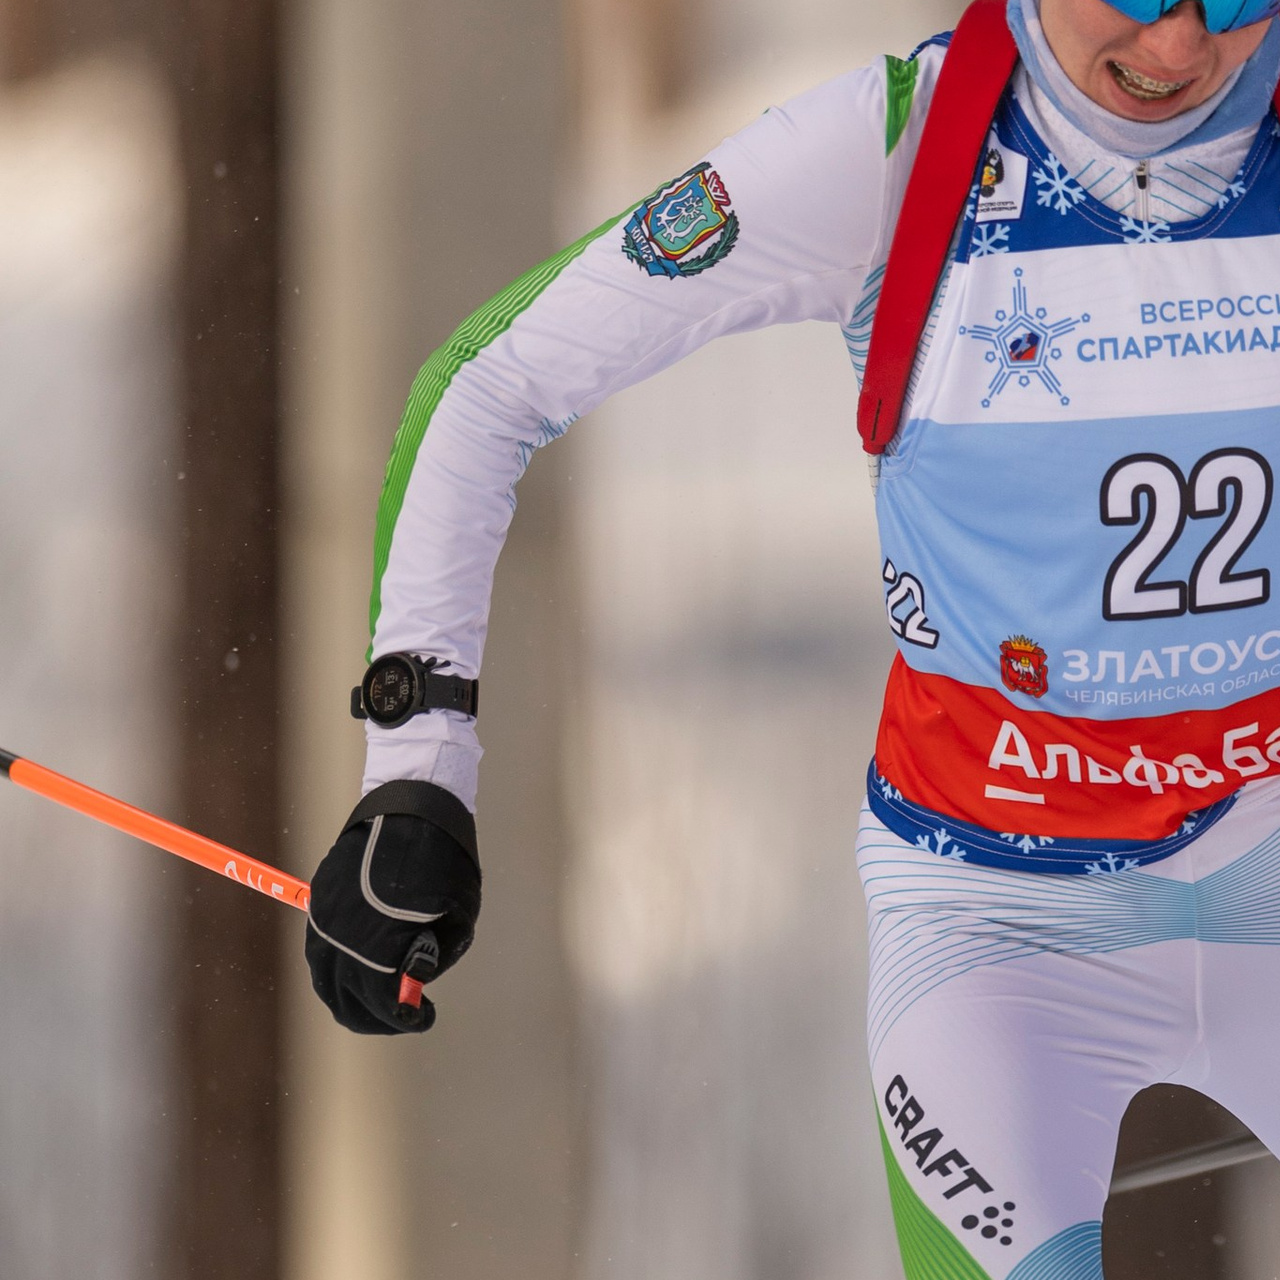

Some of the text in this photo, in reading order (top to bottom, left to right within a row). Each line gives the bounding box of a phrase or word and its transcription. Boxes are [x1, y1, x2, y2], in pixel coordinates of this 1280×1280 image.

[1100, 447, 1273, 621] 22
[1065, 682, 1216, 706] ЧЕЛЯБИНСКАЯ
[987, 719, 1224, 796] Альфа
[885, 1074, 994, 1200] CRAFT
